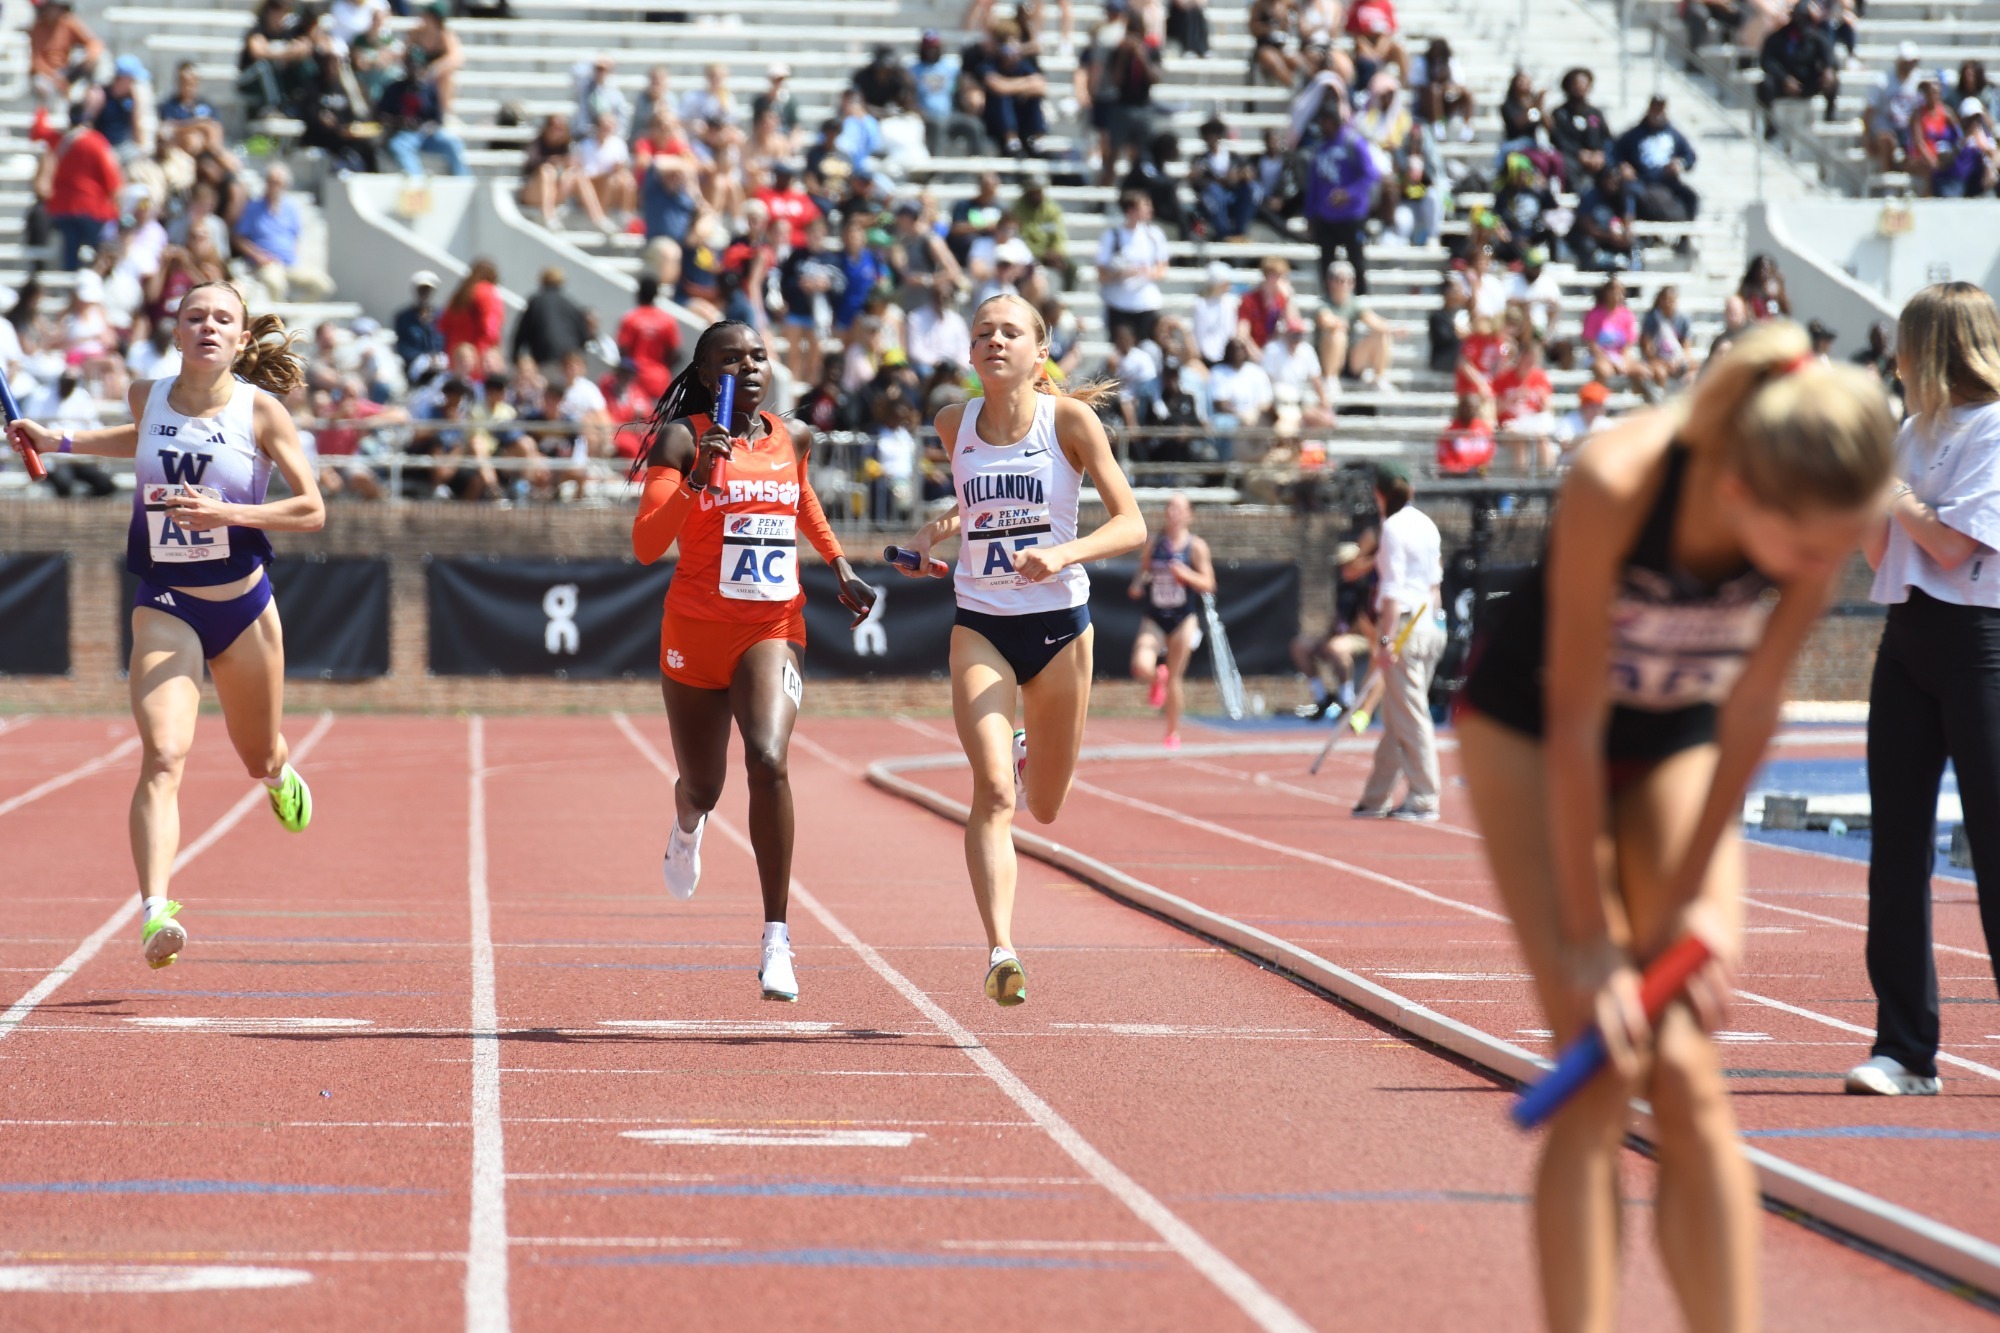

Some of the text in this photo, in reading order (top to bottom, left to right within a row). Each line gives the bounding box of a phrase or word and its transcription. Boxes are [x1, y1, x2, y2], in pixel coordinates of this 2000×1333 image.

[157, 449, 213, 485] W
[963, 473, 1044, 508] VILLANOVA
[1000, 508, 1030, 519] PENN
[758, 518, 785, 527] PENN
[998, 516, 1041, 527] RELAYS
[731, 548, 786, 584] AC
[1014, 575, 1035, 587] 25
